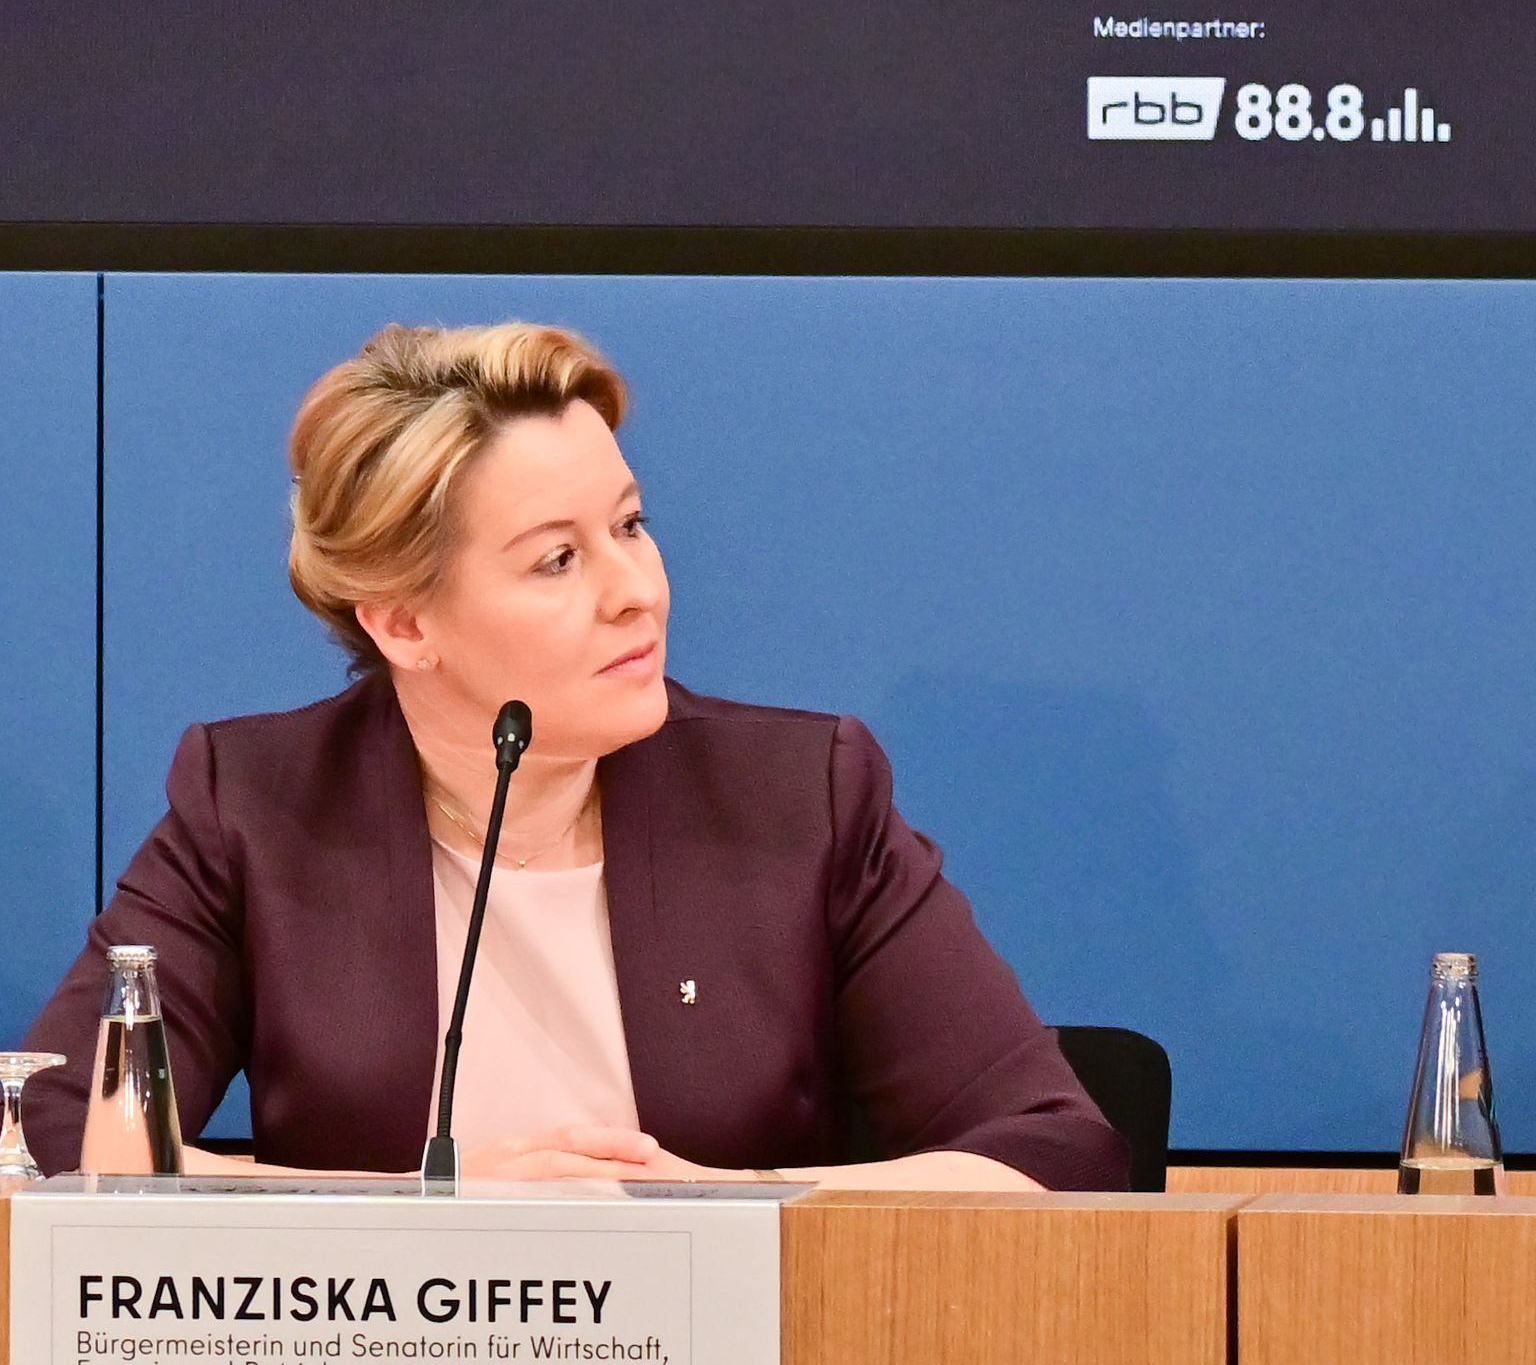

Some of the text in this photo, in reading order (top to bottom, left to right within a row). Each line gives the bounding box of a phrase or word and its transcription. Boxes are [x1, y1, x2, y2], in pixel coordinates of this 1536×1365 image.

[1093, 16, 1266, 41] Medienpartner:
[1101, 82, 1365, 142] rbb 88.8
[79, 1274, 613, 1324] FRANZISKA GIFFEY
[77, 1330, 669, 1365] Bürgermeisterin und Senatorin für Wirtschaft,
